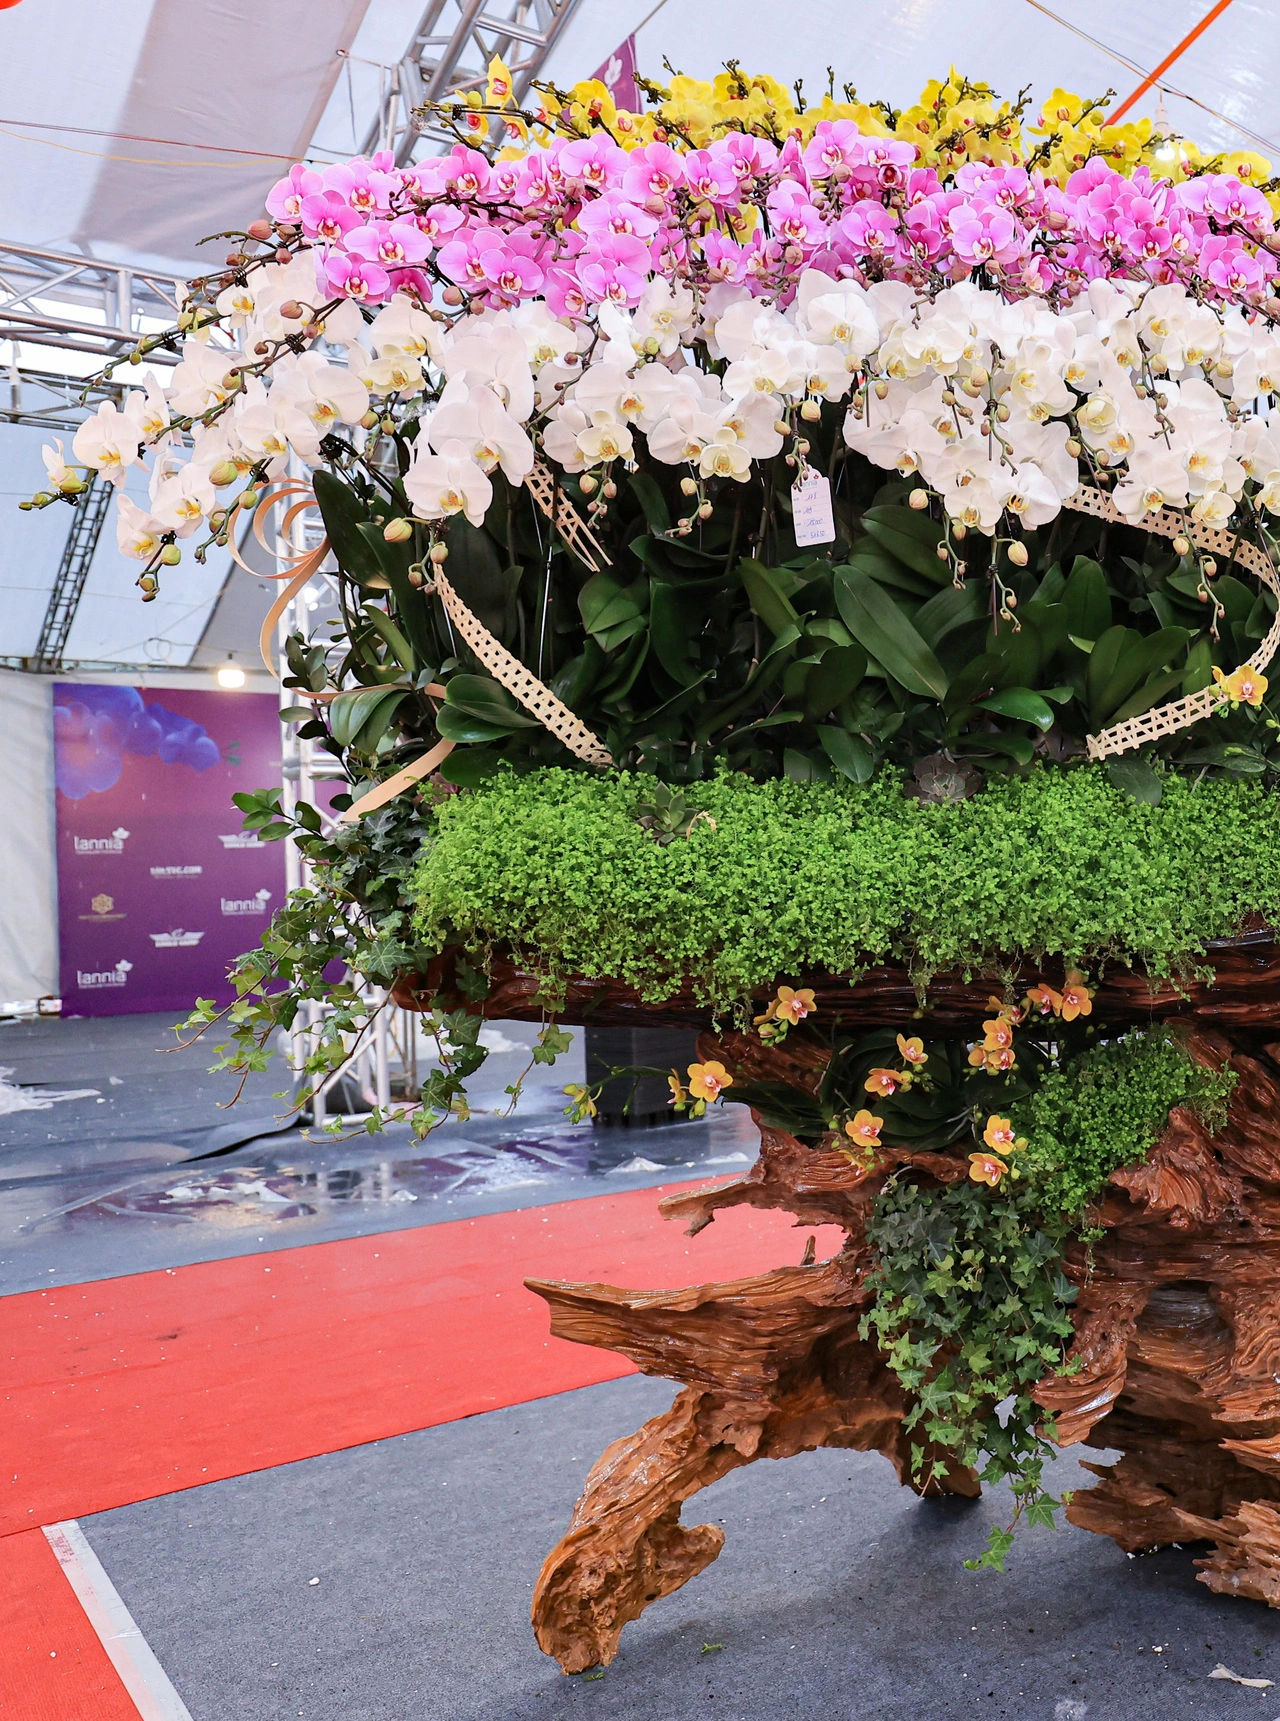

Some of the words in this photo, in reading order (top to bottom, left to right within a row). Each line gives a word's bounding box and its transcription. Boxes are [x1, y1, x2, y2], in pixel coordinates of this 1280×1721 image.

[74, 835, 124, 851] lannia
[220, 897, 267, 912] lannia
[77, 969, 128, 984] lannia
